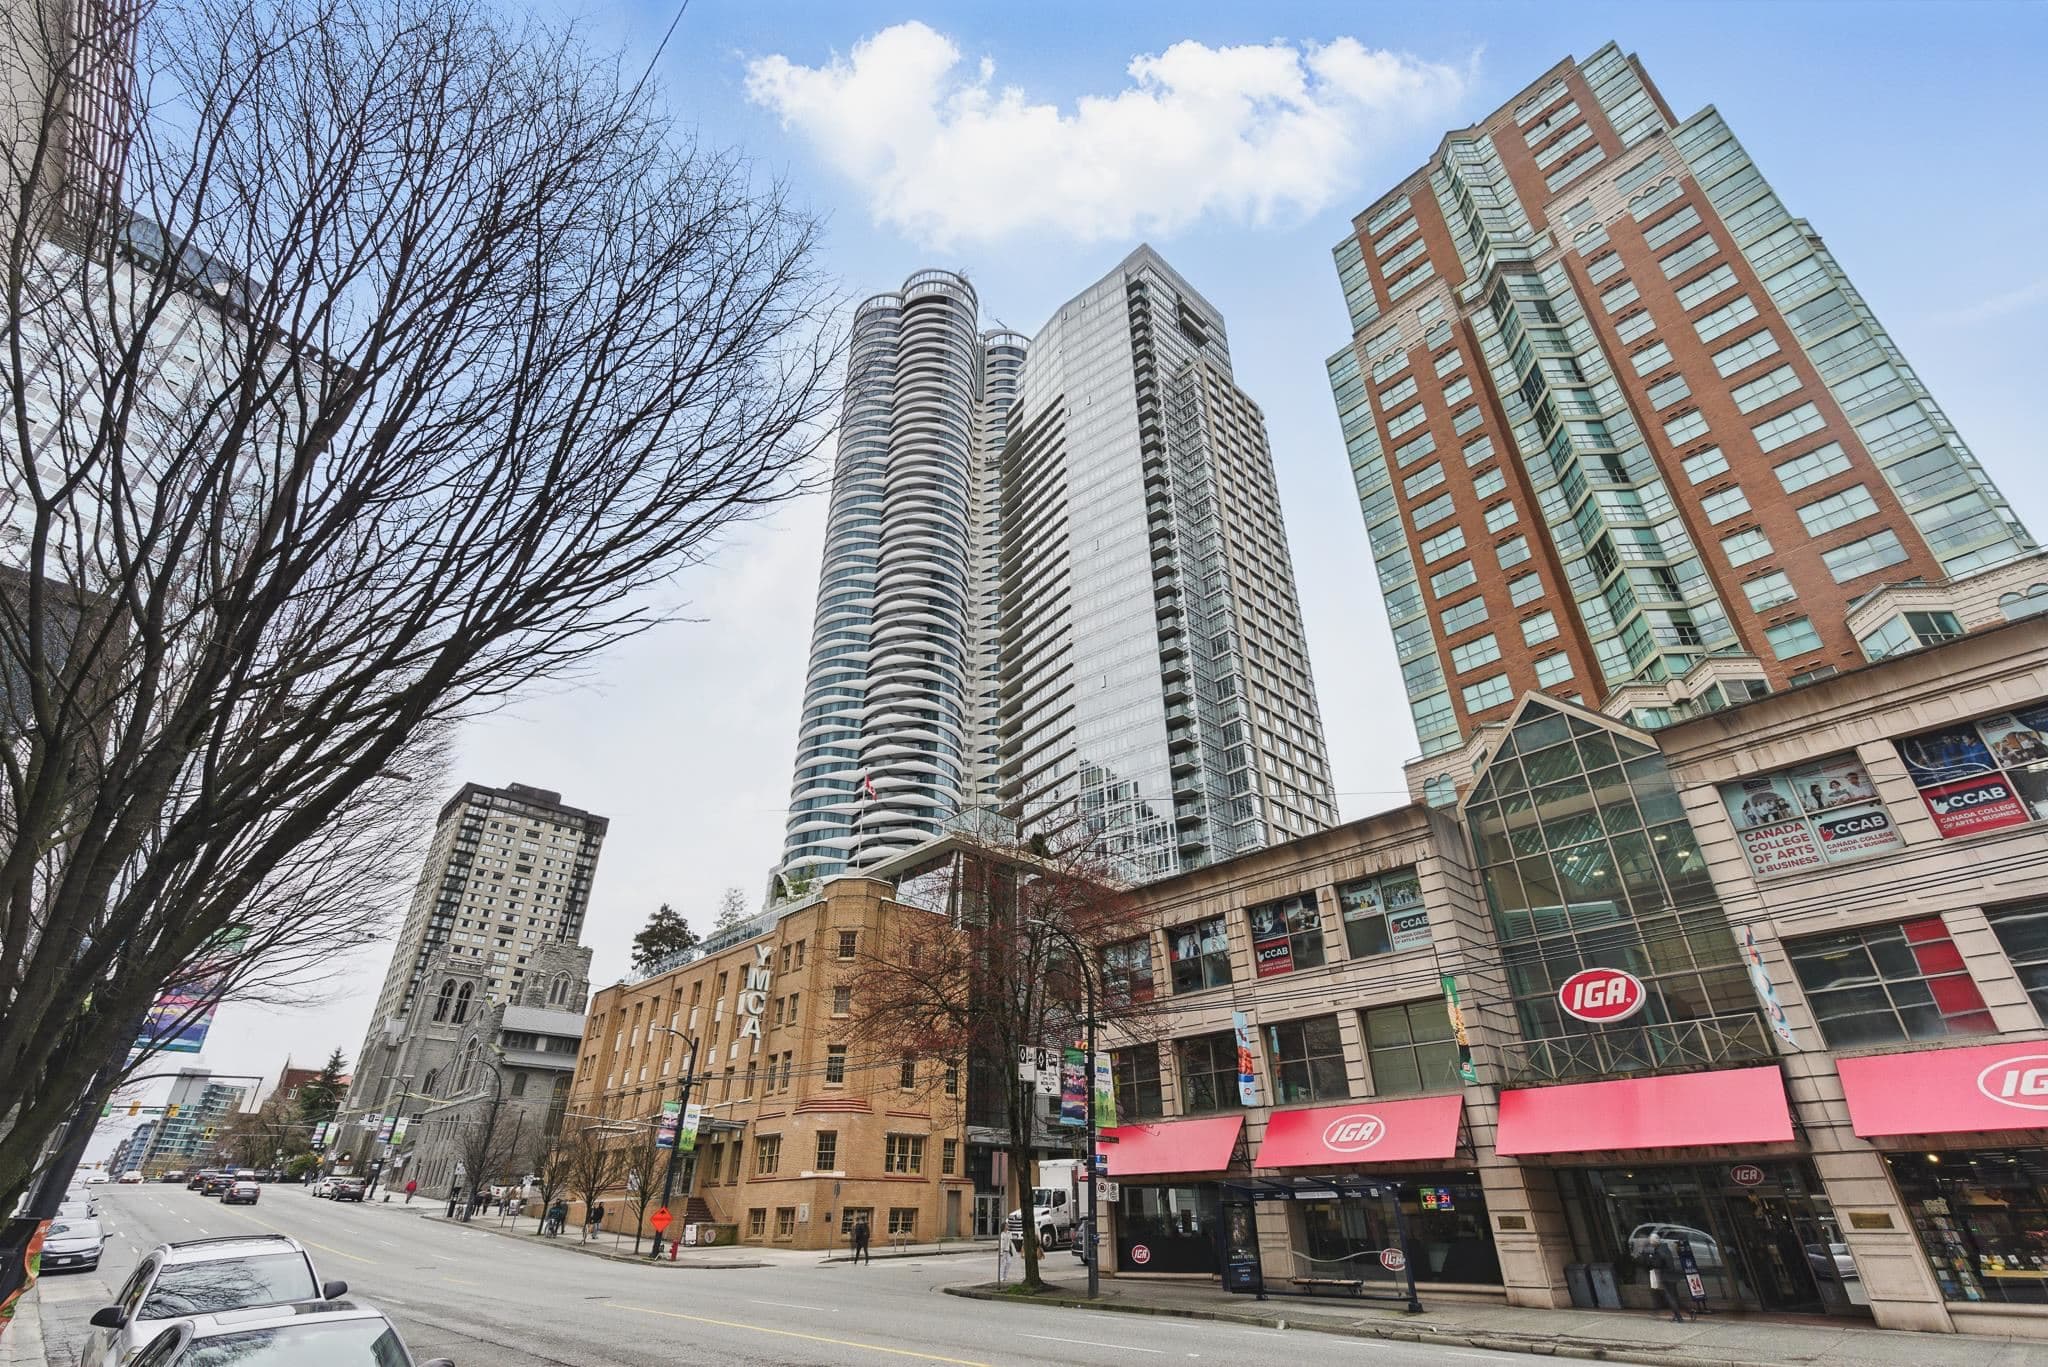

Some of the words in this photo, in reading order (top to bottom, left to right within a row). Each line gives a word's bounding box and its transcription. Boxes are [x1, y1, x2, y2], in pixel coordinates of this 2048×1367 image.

[1949, 786, 2007, 808] CCAB
[1940, 813, 1977, 824] CANADA
[1977, 803, 2018, 815] COLLEGE
[1955, 819, 1976, 828] ARTS
[1982, 809, 2022, 821] BUSINESS
[1744, 822, 1805, 842] CANADA
[1834, 815, 1886, 835] CCAB
[1748, 833, 1811, 854] COLLEGE
[1826, 841, 1858, 850] CANADA
[1859, 831, 1895, 843] COLLEGE
[1840, 845, 1858, 853] ARTS
[1864, 836, 1898, 849] BUSINESS
[1753, 853, 1773, 864] OF
[1777, 844, 1815, 860] ARTS
[1757, 865, 1766, 874] &
[1766, 855, 1820, 873] BUSINESS
[1264, 946, 1289, 959] CCAB
[741, 943, 773, 1041] YMCA
[1573, 976, 1627, 1011] IGA
[1329, 1121, 1378, 1143] IGA
[1736, 1169, 1758, 1181] IGA
[1134, 1249, 1149, 1259] IGA
